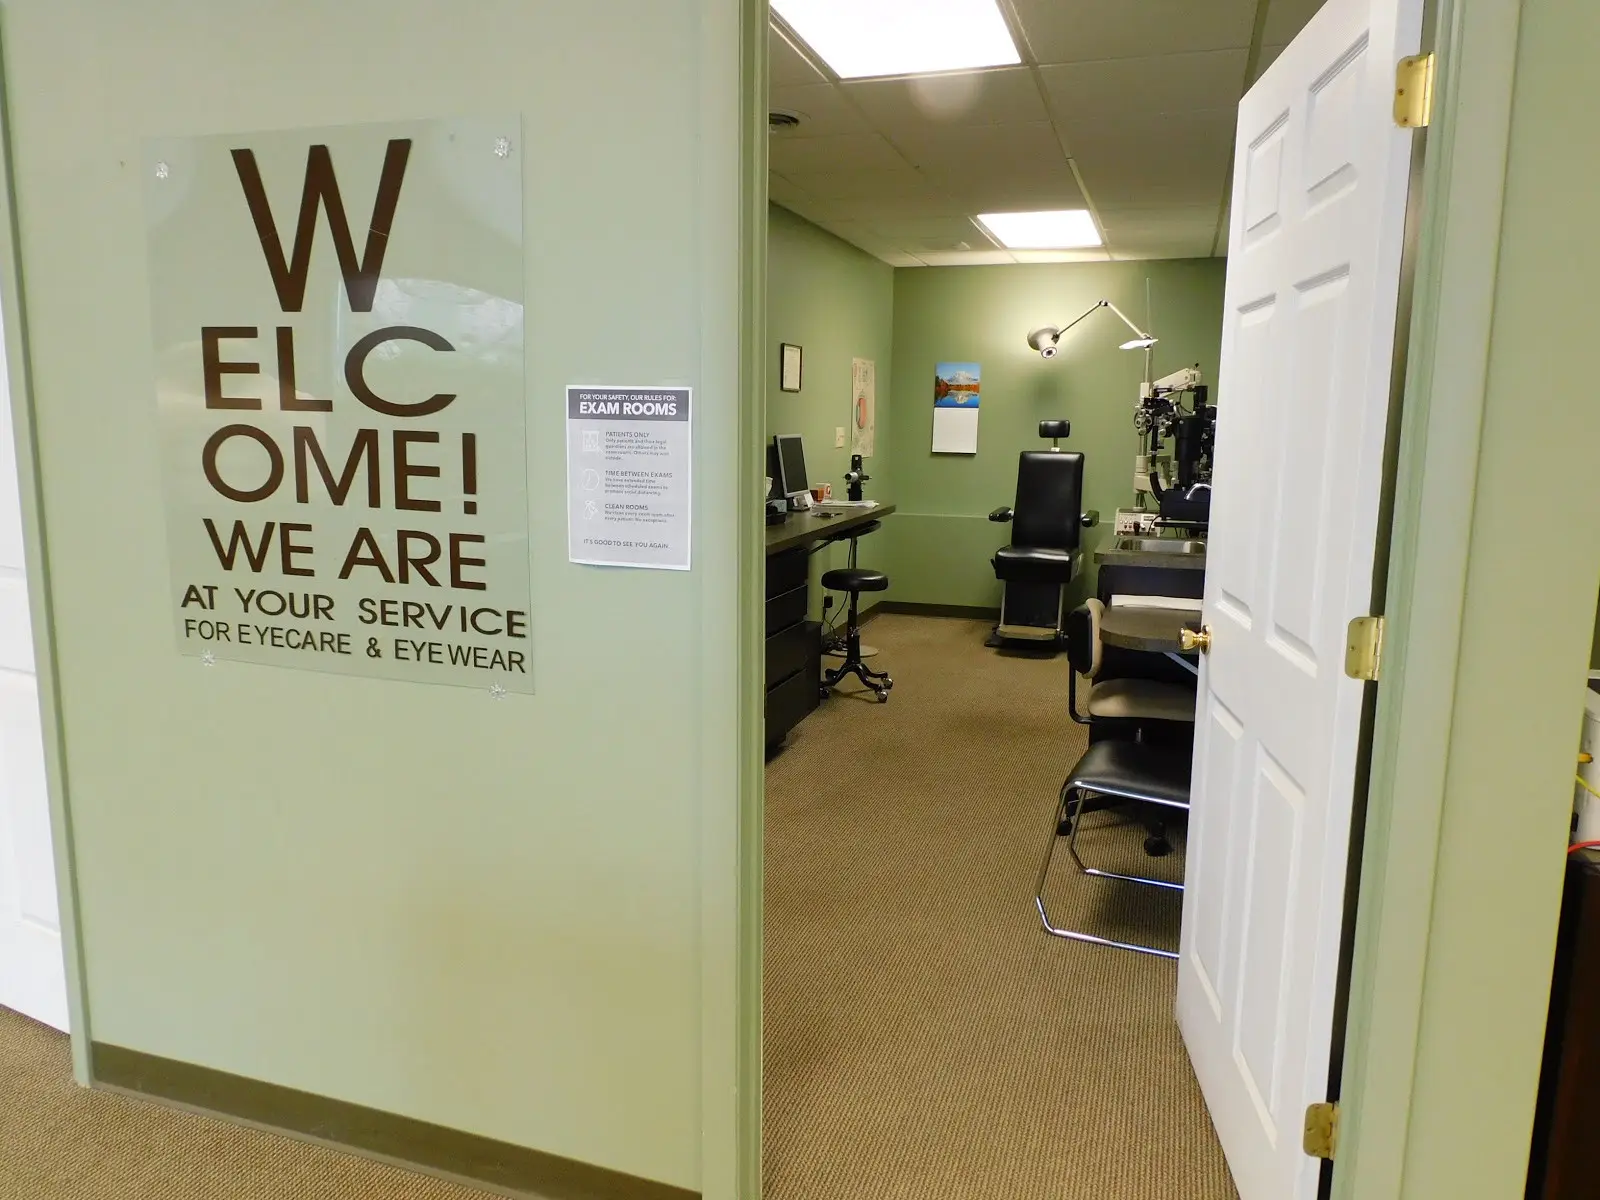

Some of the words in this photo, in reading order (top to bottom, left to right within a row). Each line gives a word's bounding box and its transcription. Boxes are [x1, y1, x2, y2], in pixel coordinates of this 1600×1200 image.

[230, 138, 412, 312] W
[201, 325, 457, 417] ELC
[580, 402, 619, 414] EXAM
[623, 402, 676, 415] ROOMS
[202, 423, 477, 515] OME!
[202, 518, 315, 577] WE
[338, 527, 487, 591] ARE
[181, 584, 219, 610] AT
[235, 587, 335, 621] YOUR
[358, 597, 527, 638] SERVICE
[184, 618, 231, 643] FOR
[238, 624, 352, 655] EYECARE
[366, 636, 382, 658] &
[394, 638, 526, 673] EYEWEAR
